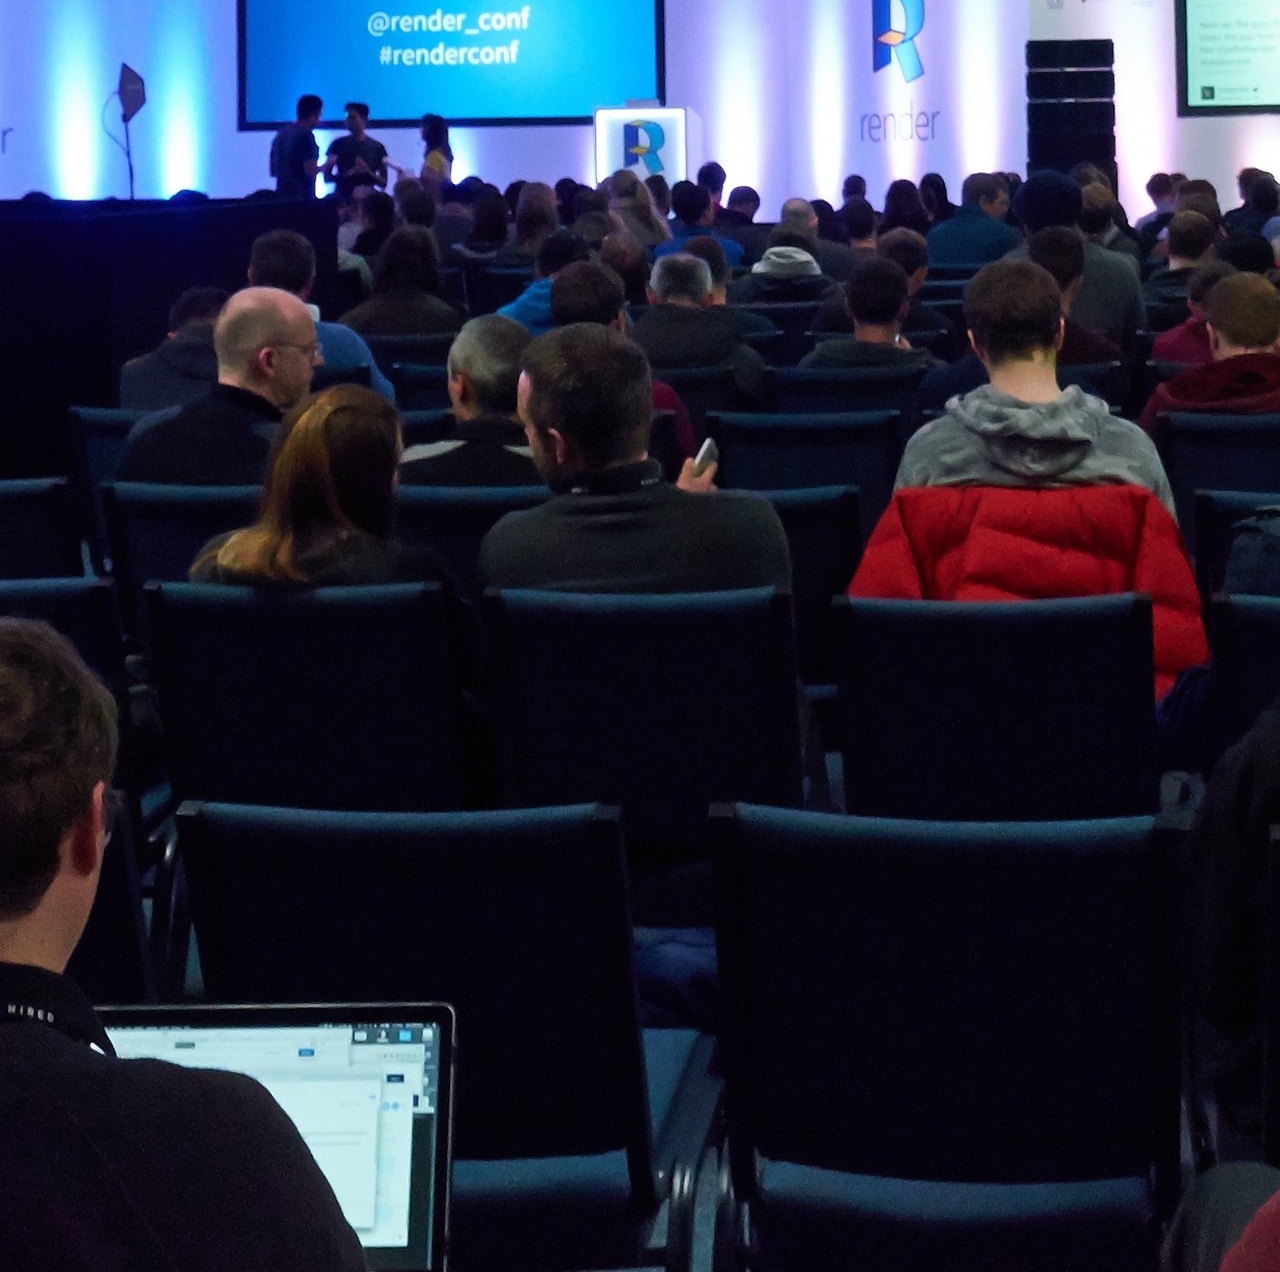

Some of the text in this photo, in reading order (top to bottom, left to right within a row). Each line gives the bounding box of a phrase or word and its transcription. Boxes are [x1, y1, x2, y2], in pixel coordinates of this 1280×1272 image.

[367, 5, 532, 37] @render_conf
[379, 39, 520, 66] #renderconf
[859, 100, 941, 143] render
[7, 1003, 55, 1023] HIRED
